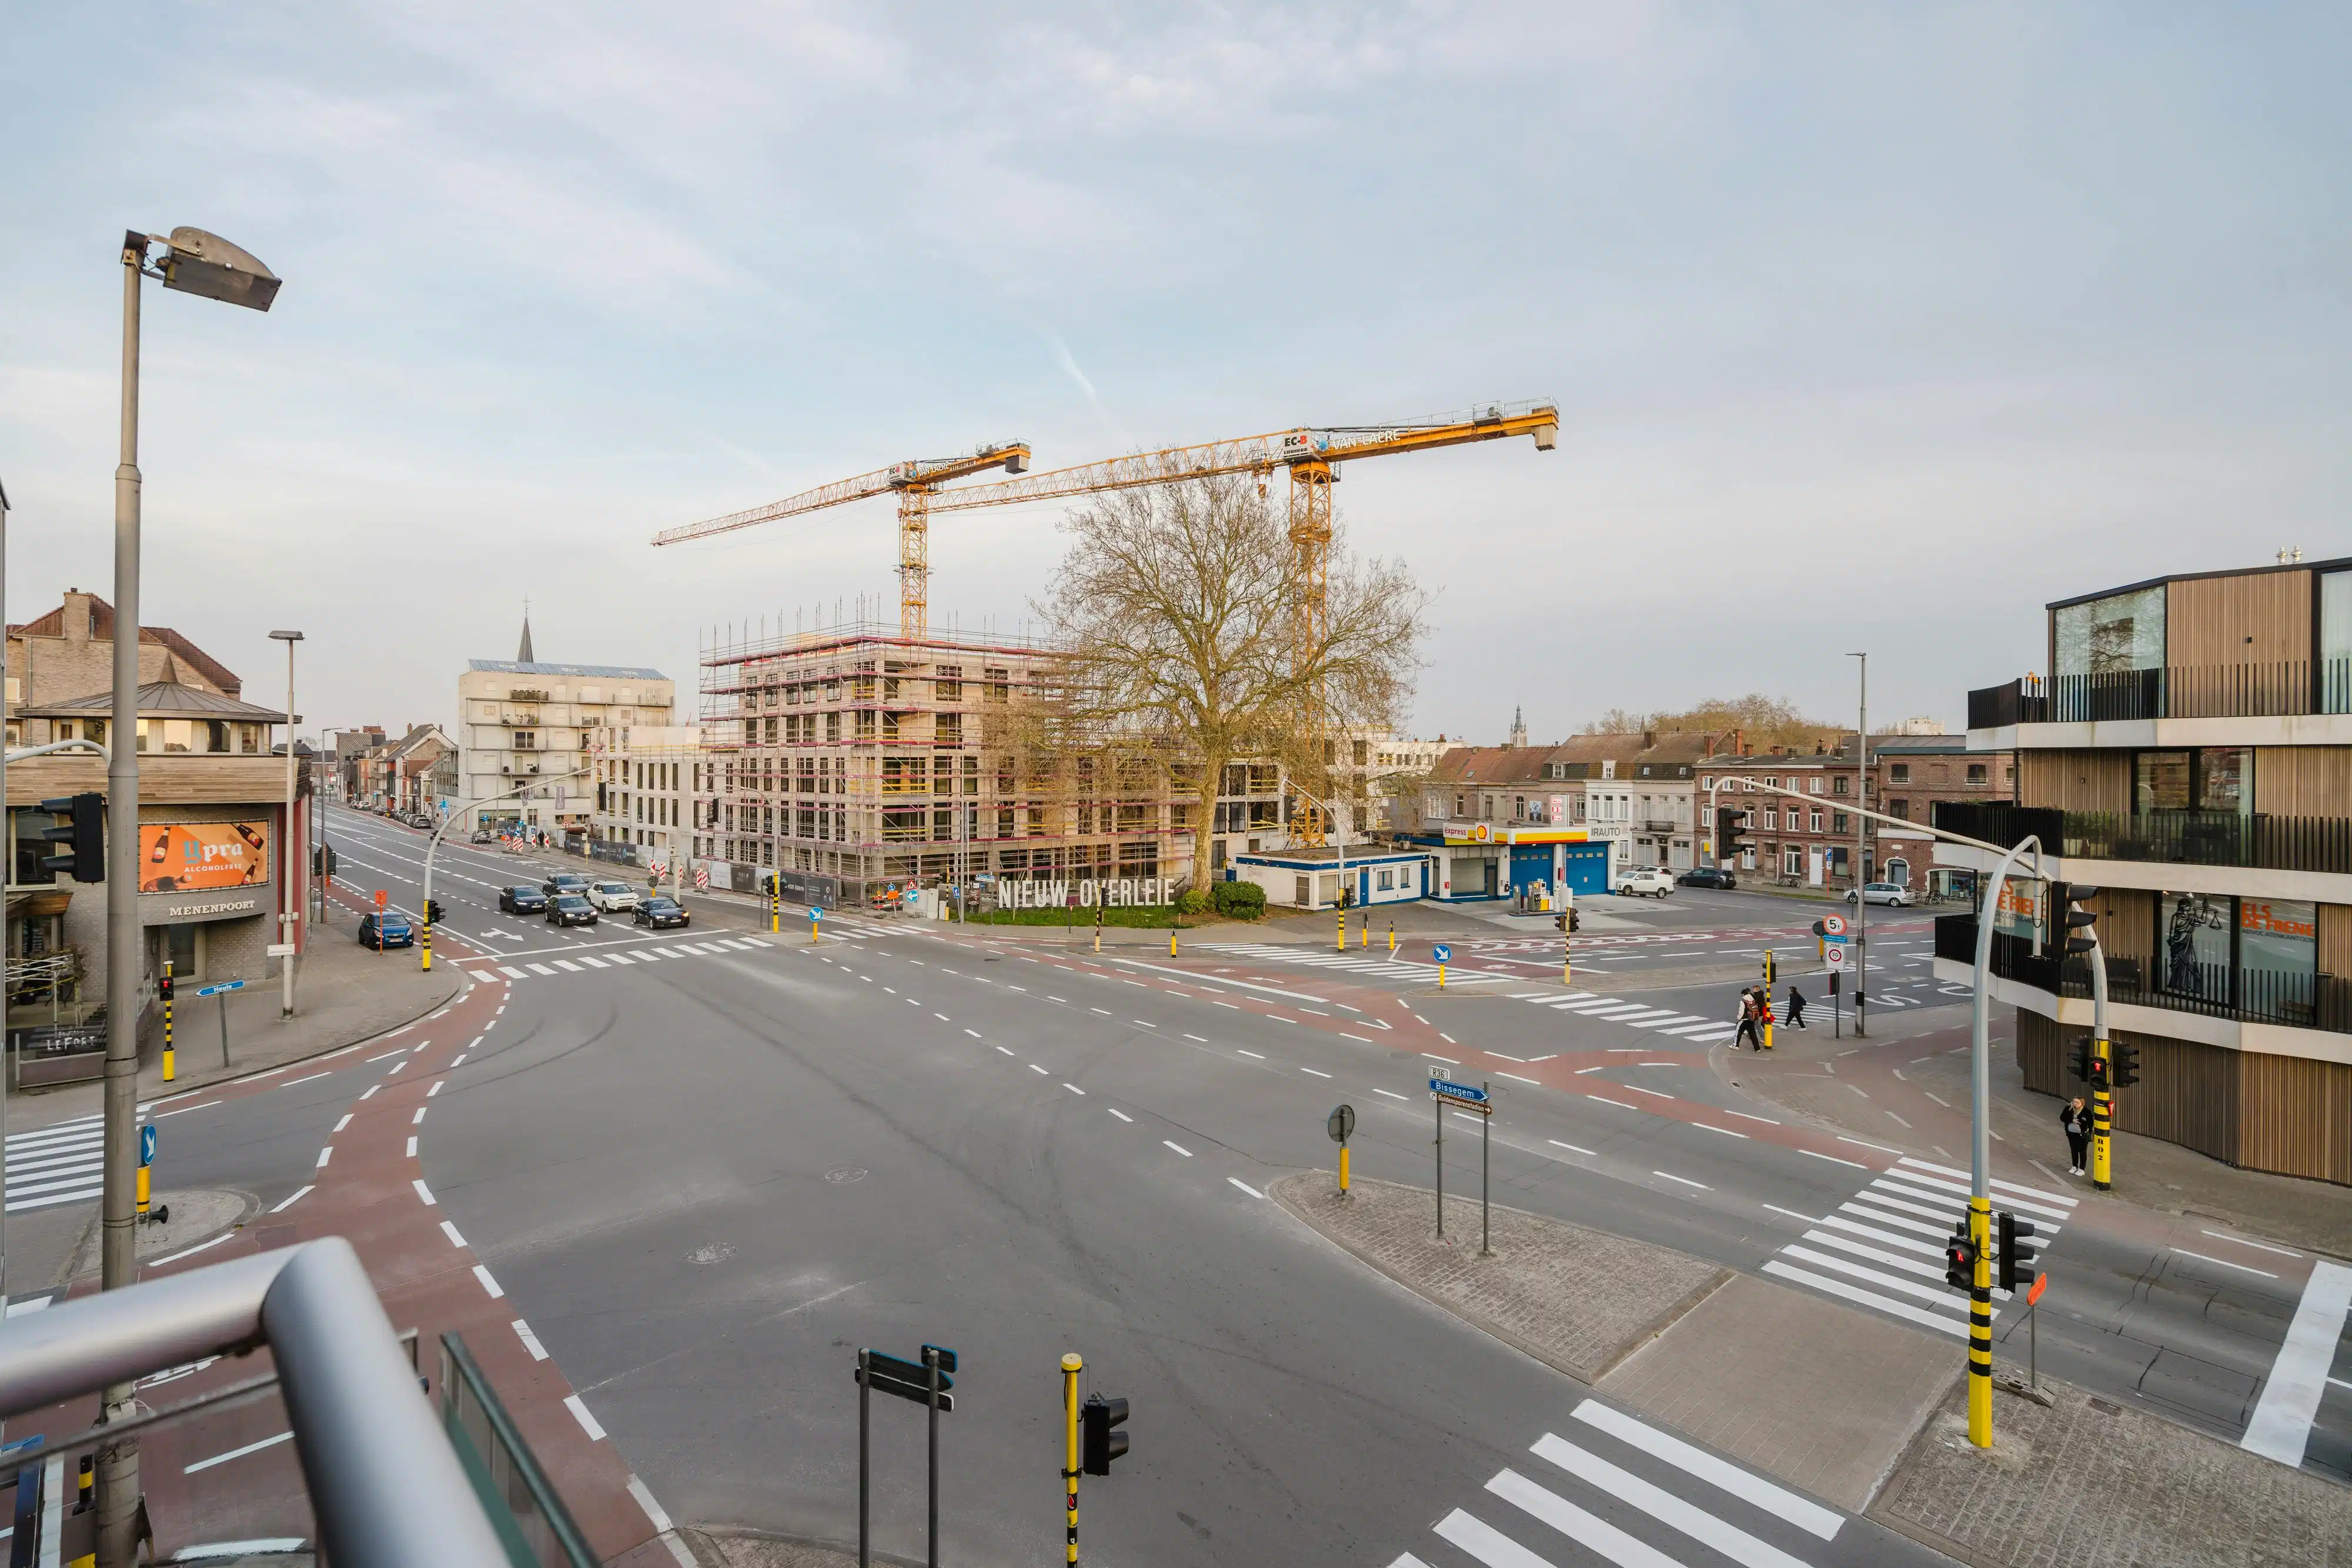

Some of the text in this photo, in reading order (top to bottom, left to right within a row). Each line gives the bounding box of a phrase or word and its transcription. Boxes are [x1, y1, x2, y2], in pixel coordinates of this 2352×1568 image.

[1284, 435, 1307, 447] EC-B
[1332, 429, 1401, 450] VAN LAERE
[917, 467, 930, 477] VAN
[1444, 828, 1466, 836] express
[184, 863, 243, 872] ALCOHOLFREE
[998, 878, 1175, 908] NIEUW OVERLEIE
[169, 900, 255, 917] MENENPOORT
[2241, 902, 2272, 919] ELS
[2241, 914, 2315, 937] DE FRENE
[213, 983, 232, 992] Heule
[1433, 1069, 1445, 1078] R36
[1436, 1082, 1474, 1098] Bissegem
[1438, 1094, 1484, 1112] Guldensporenstadion
